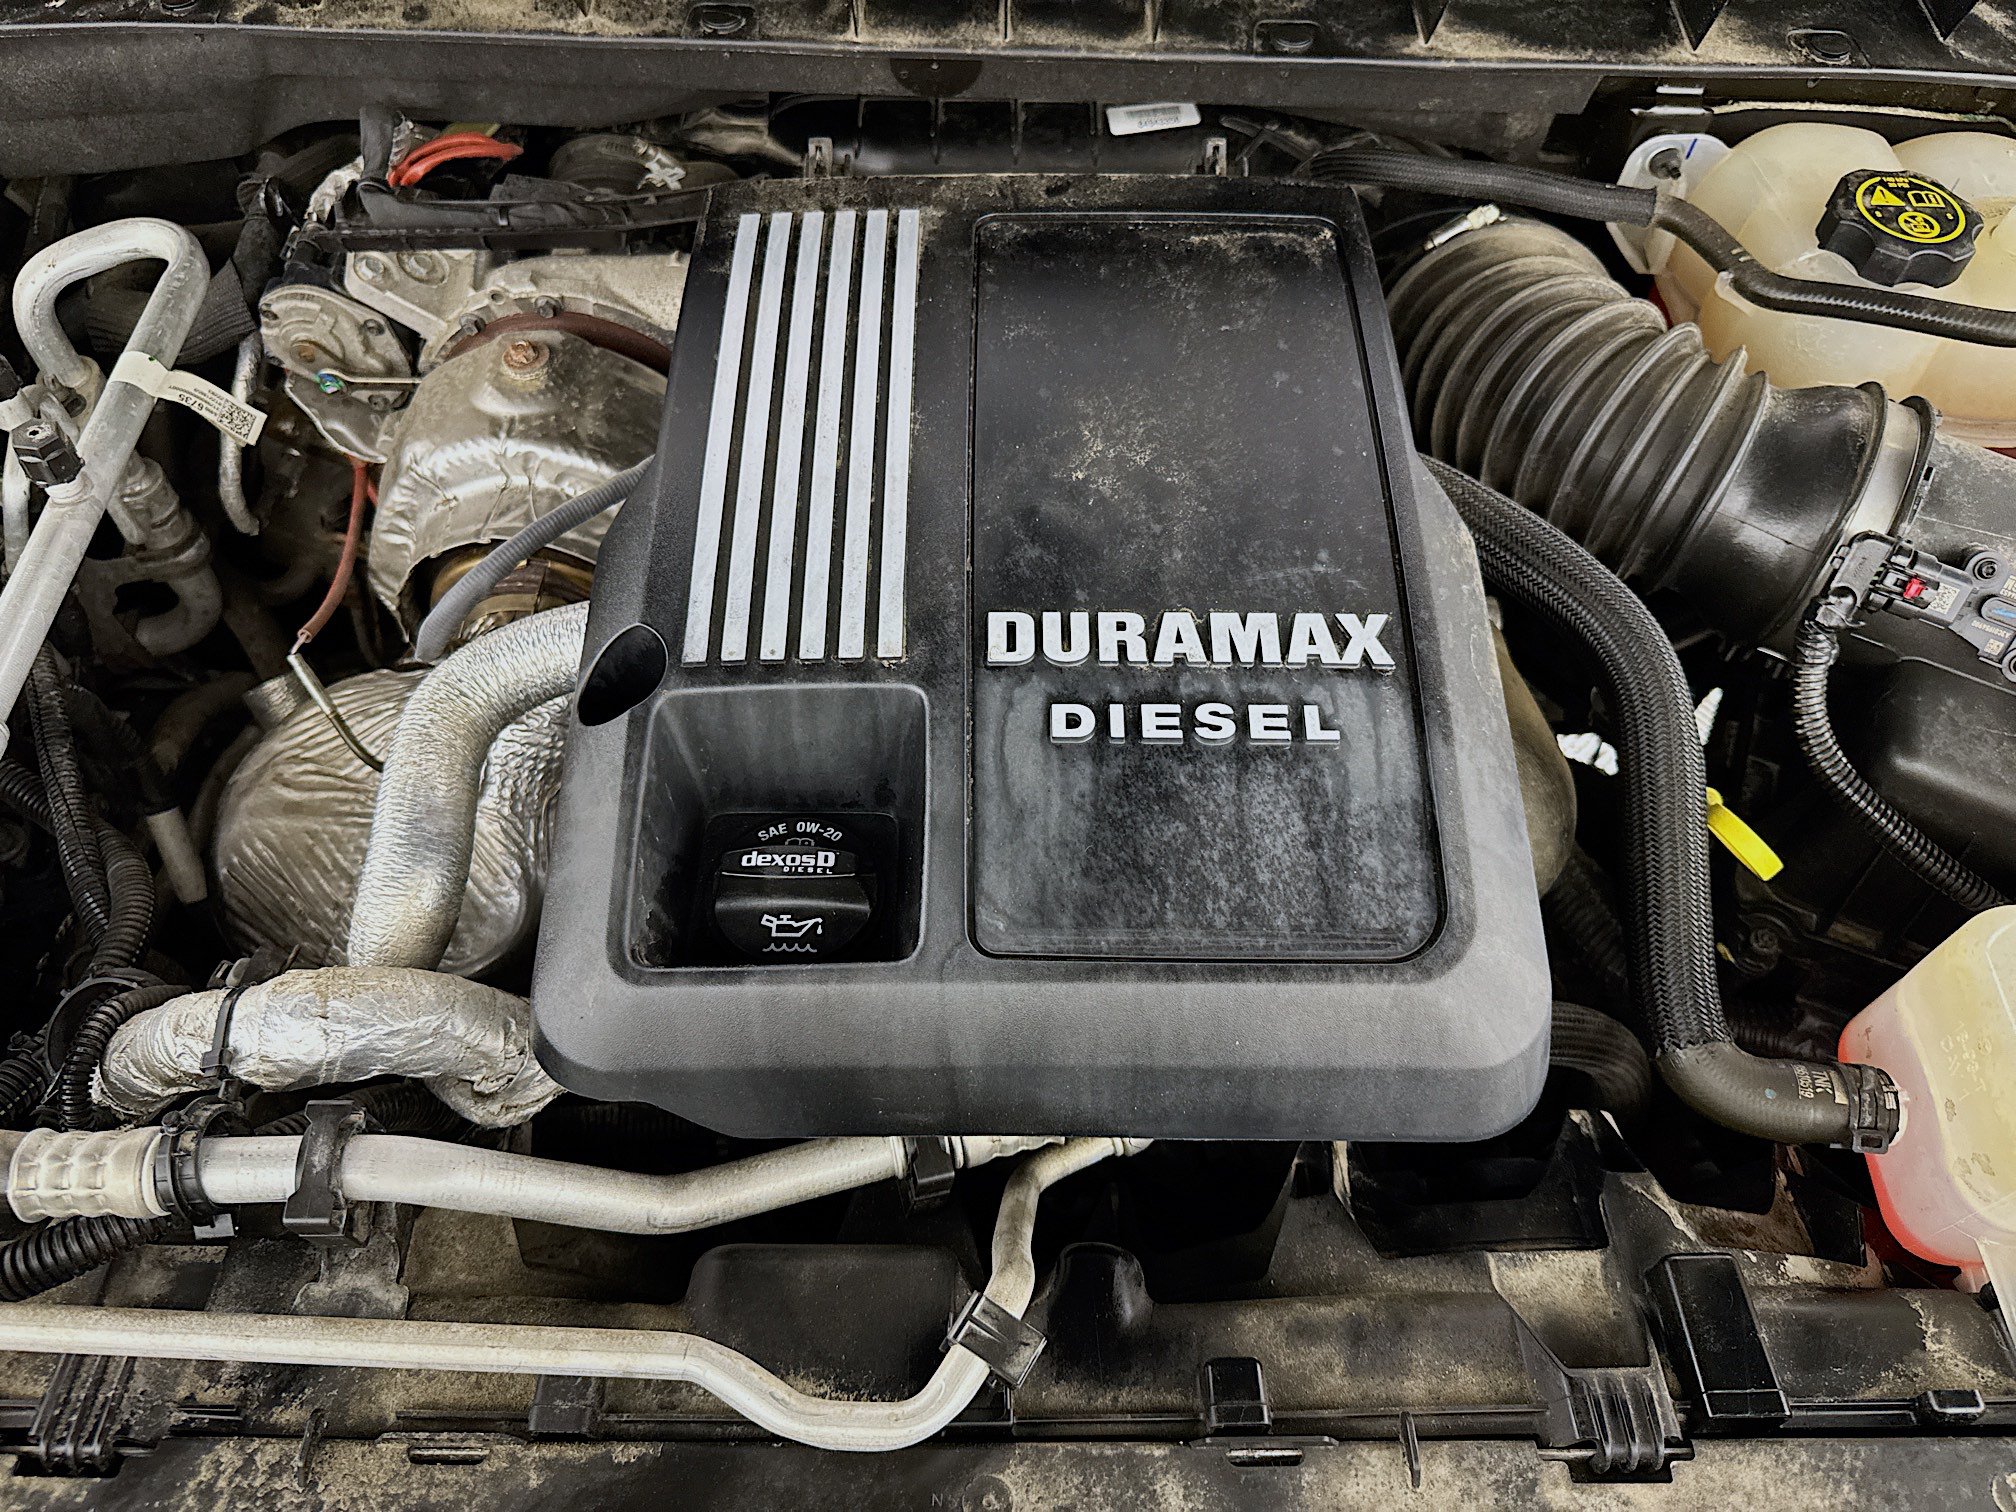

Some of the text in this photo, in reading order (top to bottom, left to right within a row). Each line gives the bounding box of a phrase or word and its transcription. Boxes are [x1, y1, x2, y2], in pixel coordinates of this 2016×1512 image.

[179, 393, 204, 411] 6735
[986, 611, 1396, 668] DURAMAX
[1051, 703, 1341, 744] DIESEL
[758, 821, 843, 841] SAE 0W-20
[741, 851, 836, 867] dexosD
[783, 866, 833, 874] DIESEL
